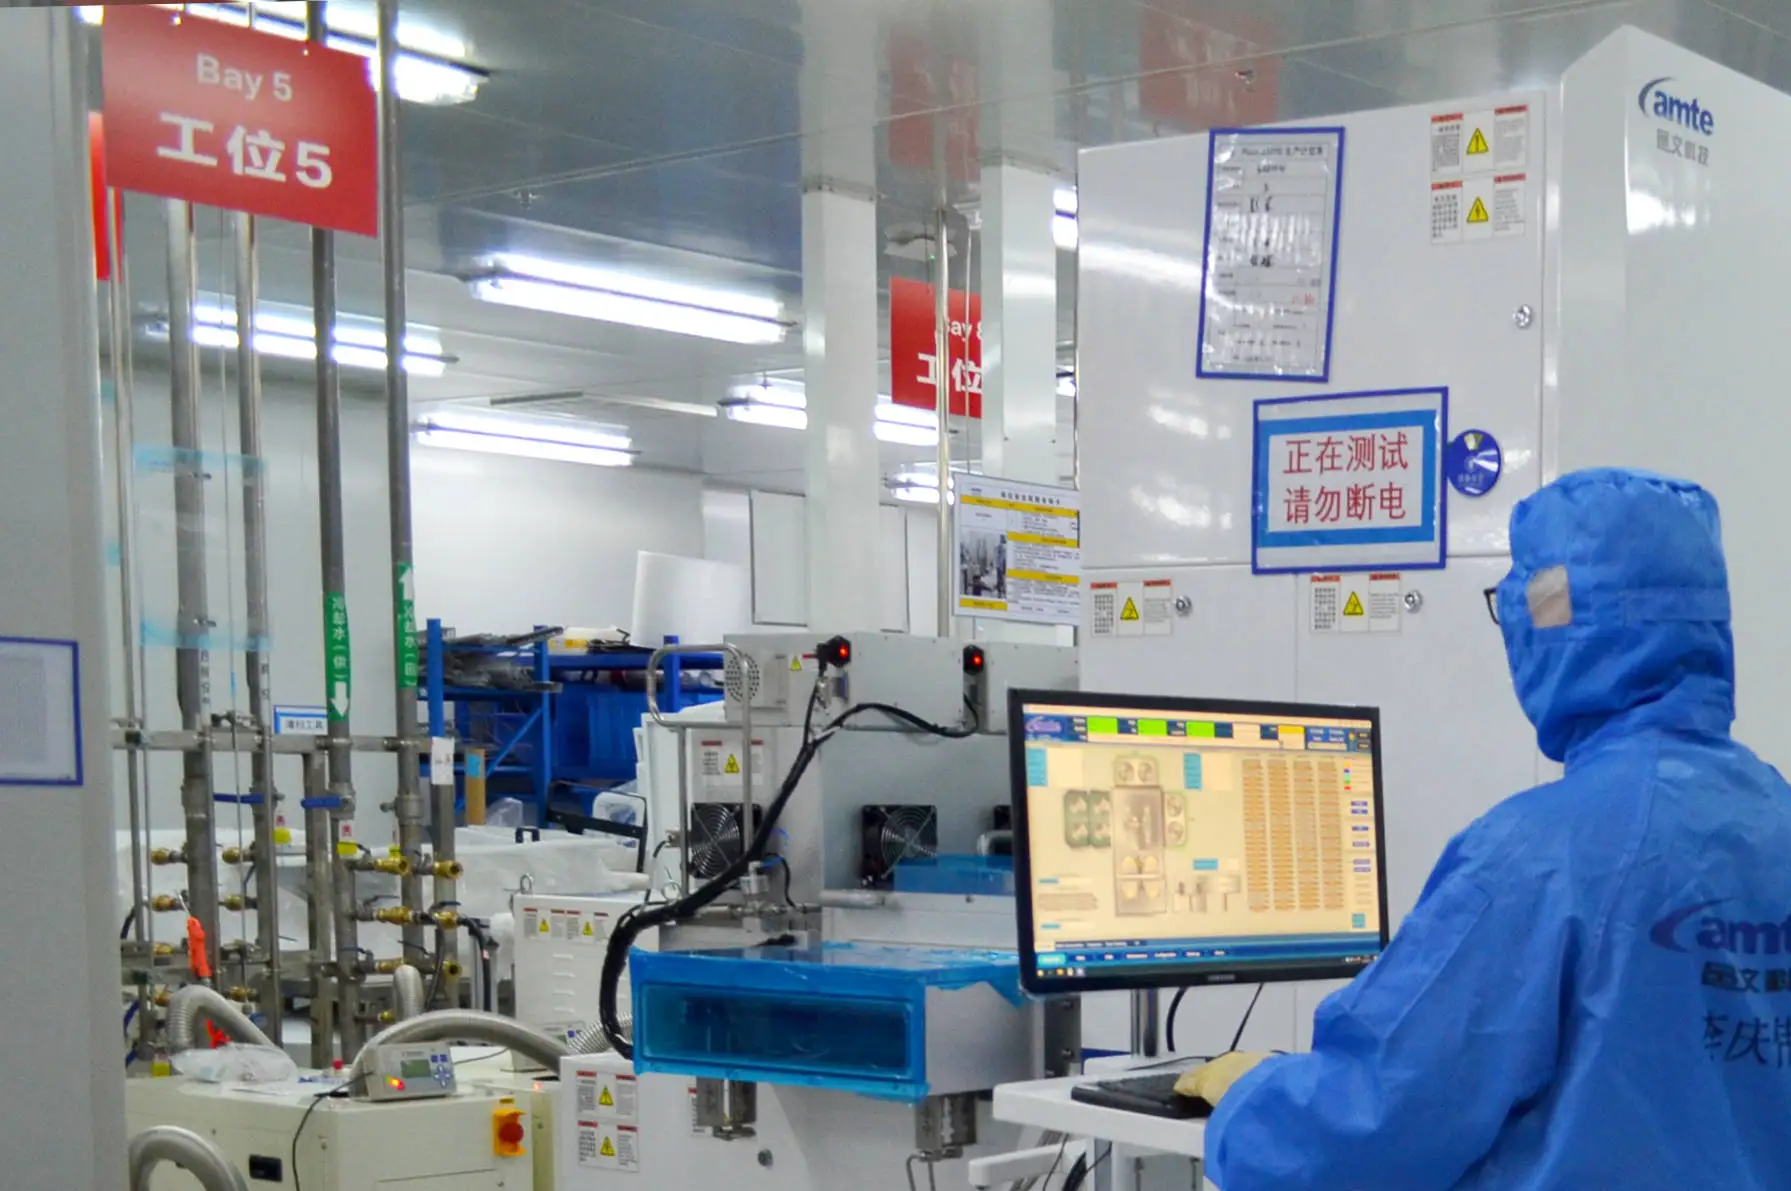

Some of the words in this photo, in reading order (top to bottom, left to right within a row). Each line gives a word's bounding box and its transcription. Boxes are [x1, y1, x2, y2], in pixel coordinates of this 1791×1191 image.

[196, 52, 263, 101] Bay
[273, 72, 293, 102] 5
[156, 111, 332, 189] 工位5
[1283, 431, 1409, 475] 正在测试
[1283, 481, 1407, 525] 请勿断电
